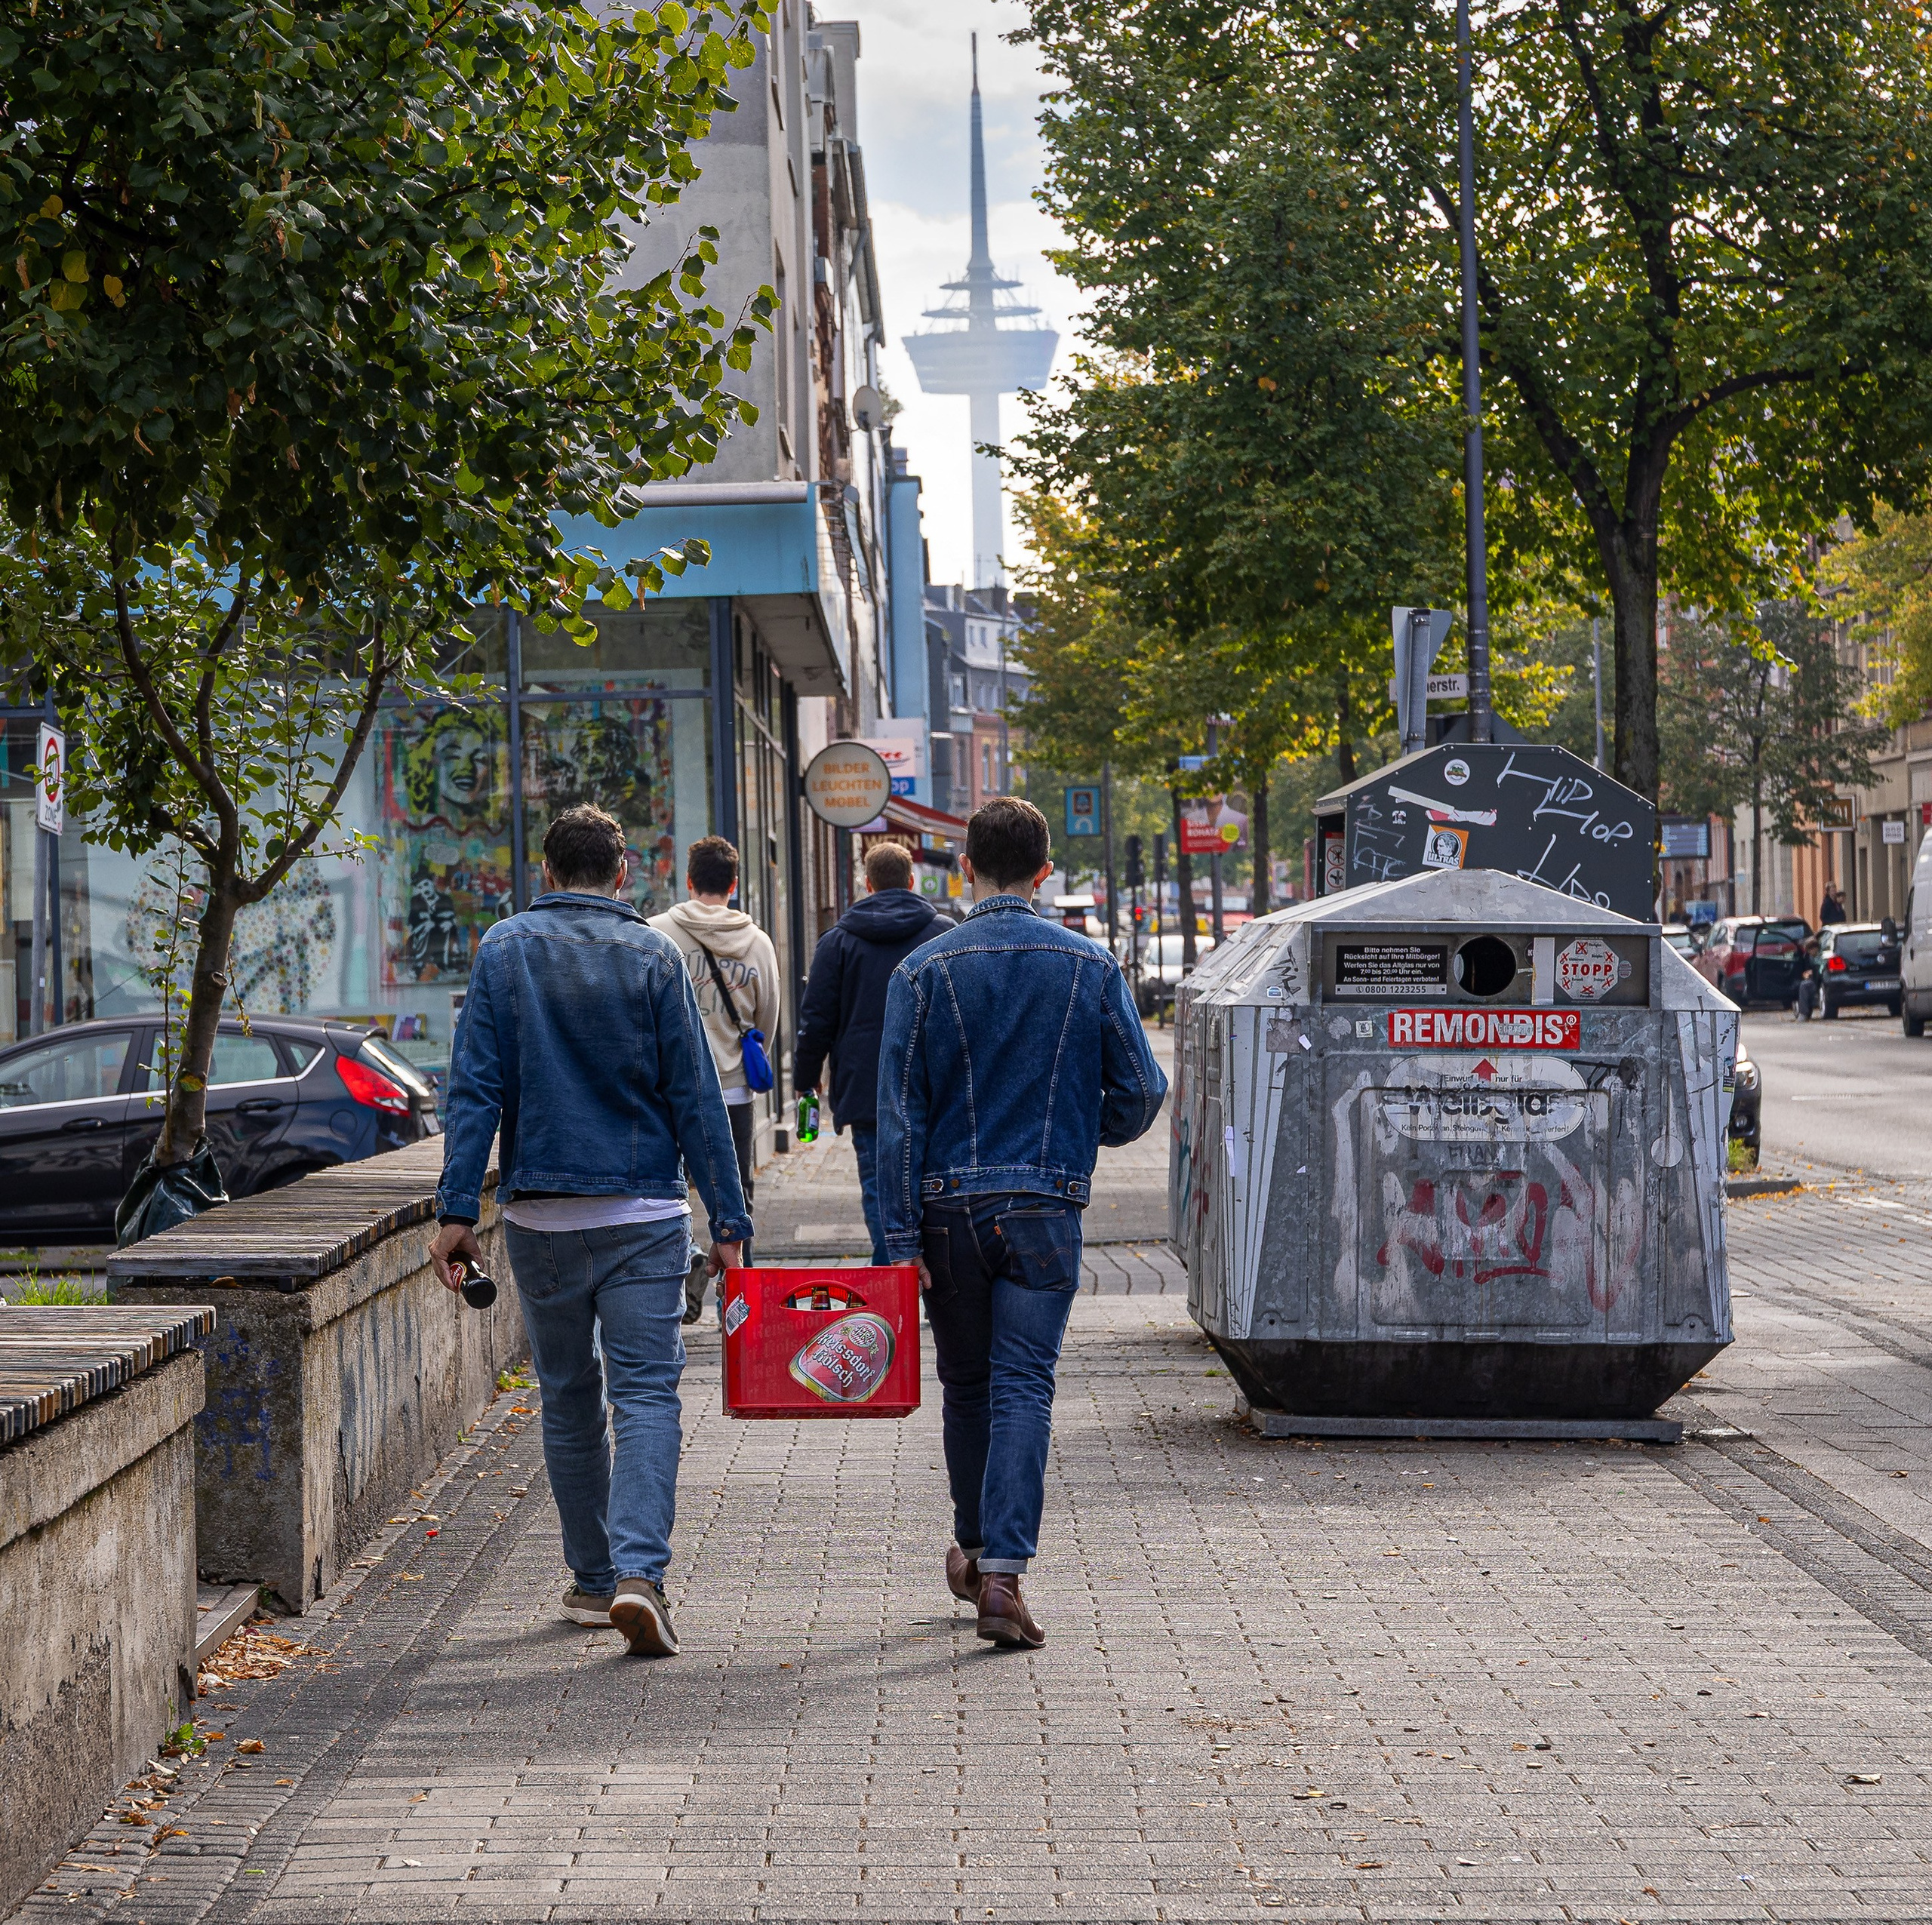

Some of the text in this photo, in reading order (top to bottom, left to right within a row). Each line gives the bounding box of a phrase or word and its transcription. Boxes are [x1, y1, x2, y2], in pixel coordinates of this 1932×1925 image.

[823, 762, 869, 774] BILDER
[812, 780, 881, 792] LEUCHTEN
[1427, 851, 1460, 867] ULTRAS
[1562, 964, 1612, 976] STOPP
[1365, 986, 1426, 994] 0800 1223255
[817, 1334, 875, 1382] Reissdorf
[813, 1349, 854, 1387] Kölsch
